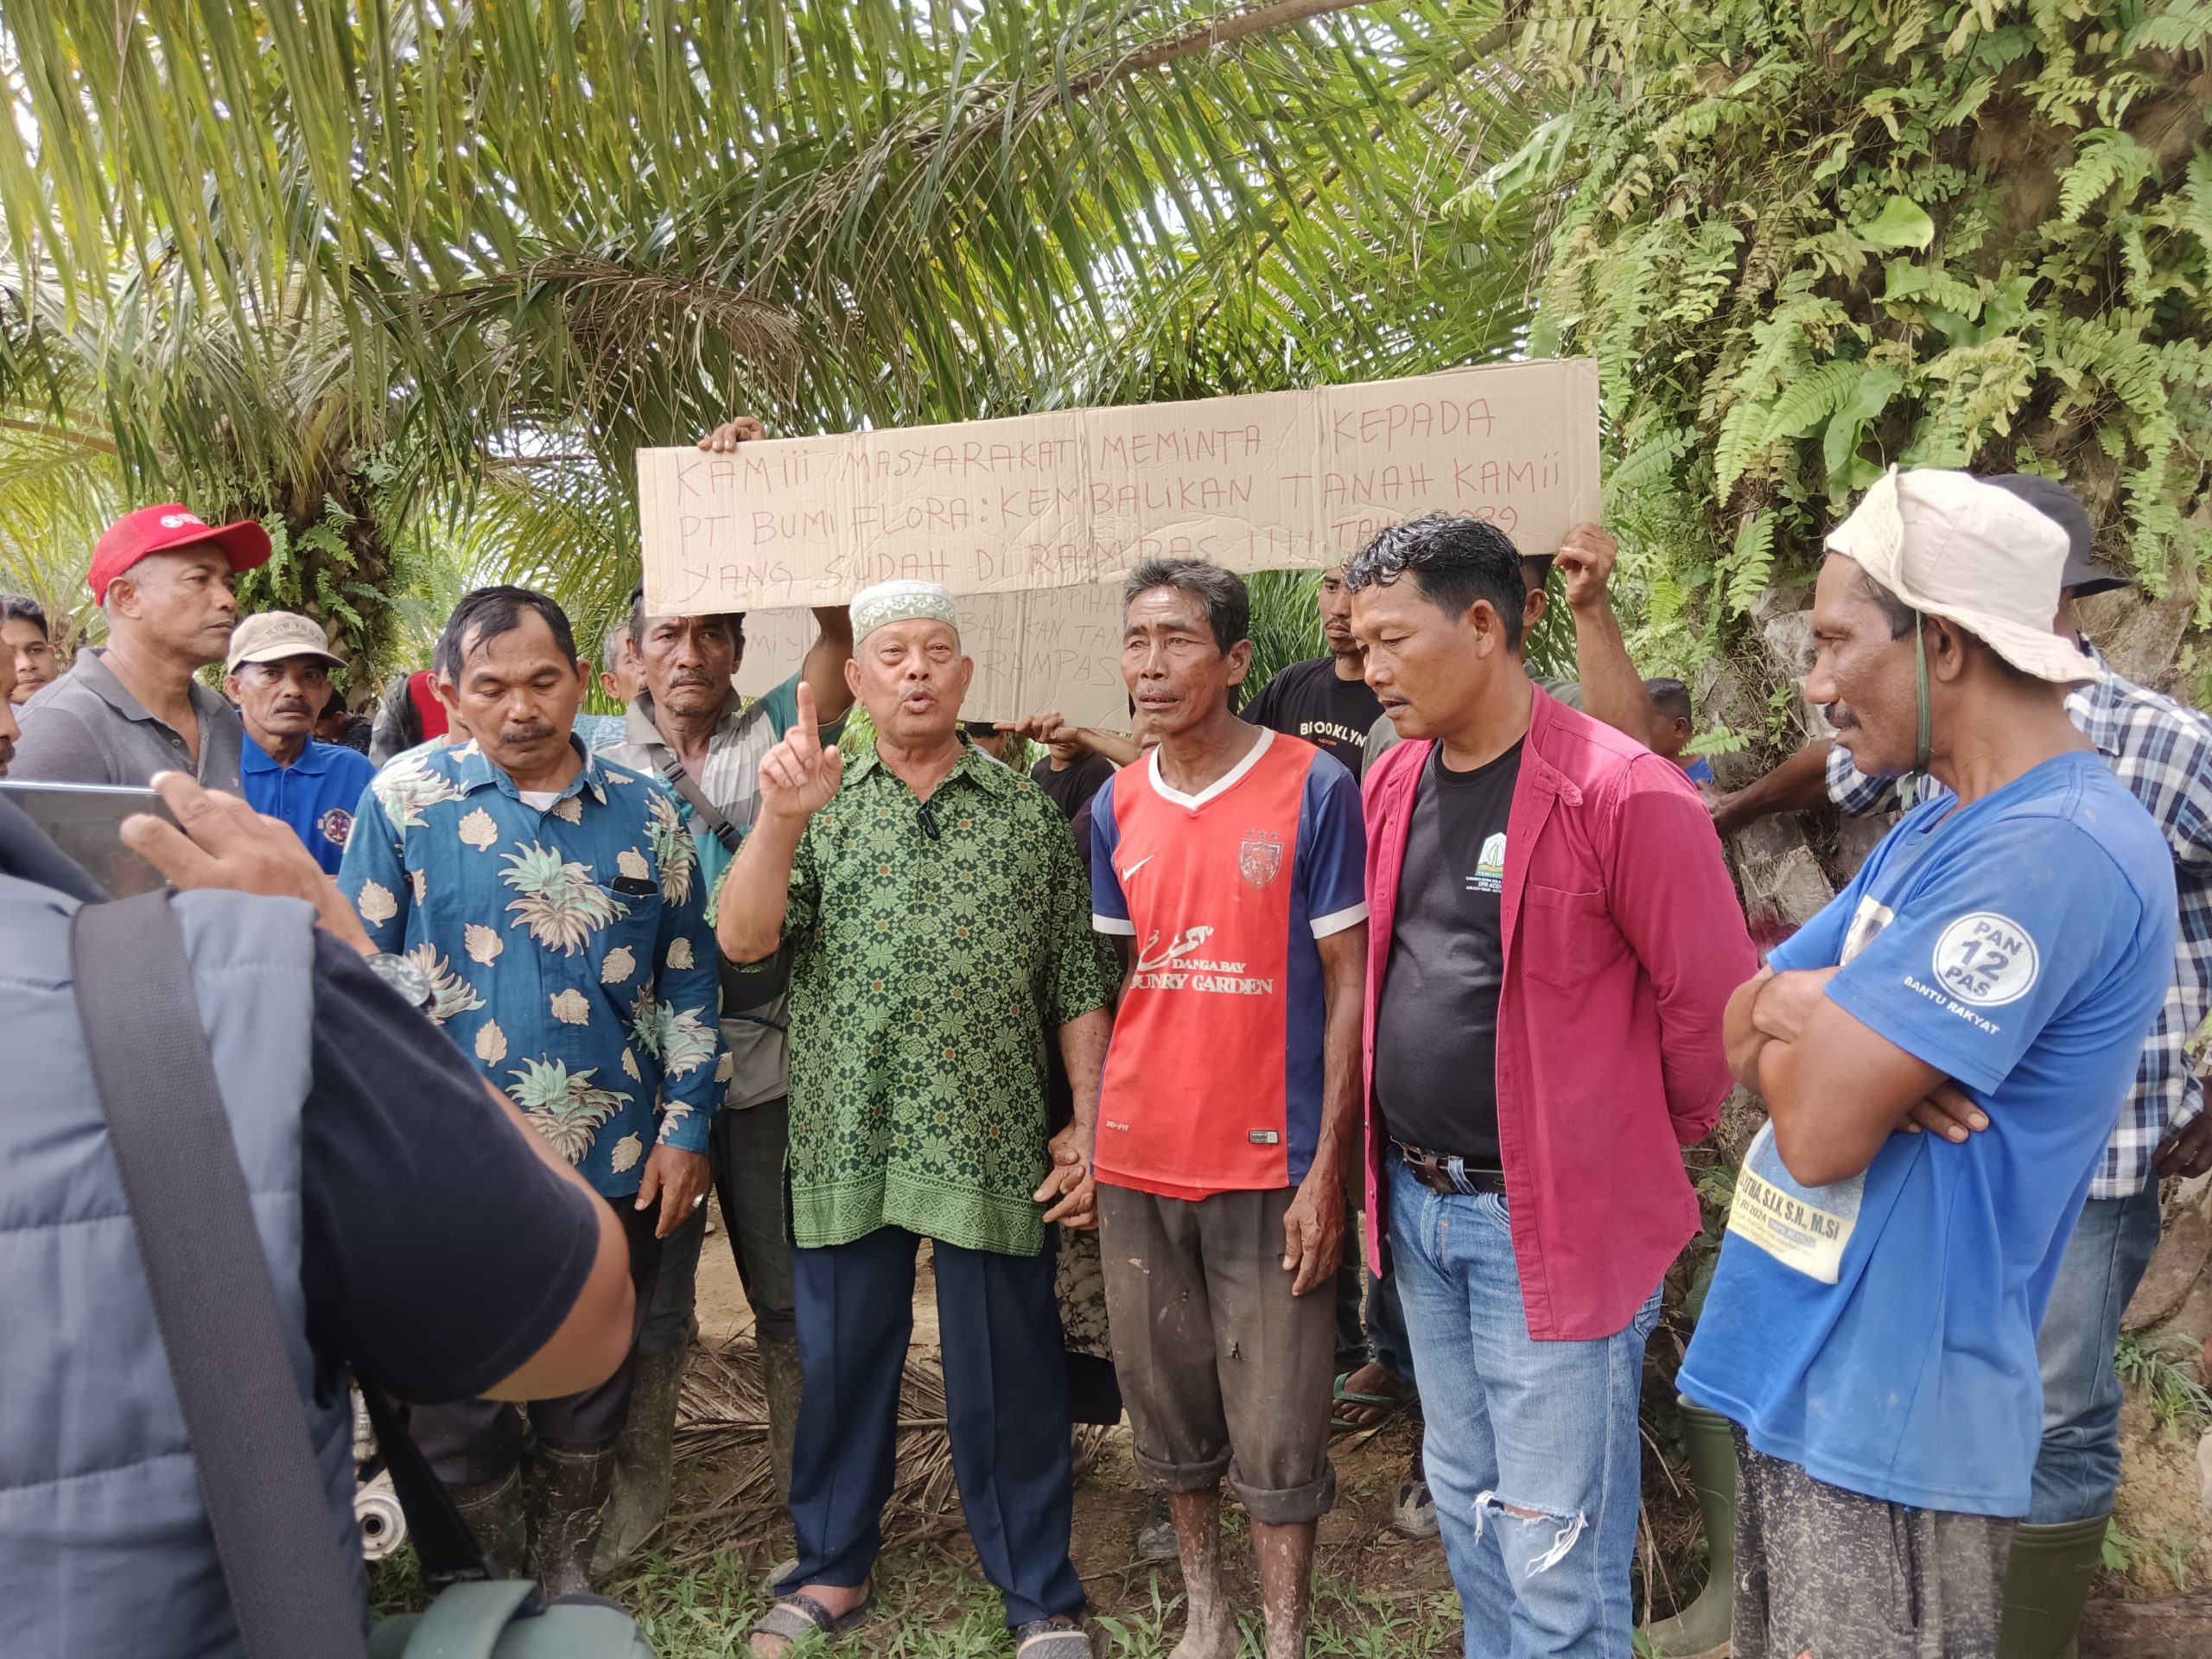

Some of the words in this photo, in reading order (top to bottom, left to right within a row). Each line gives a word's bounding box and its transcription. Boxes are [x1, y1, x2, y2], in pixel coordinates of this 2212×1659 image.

[841, 439, 1075, 483] MASYARAKAT
[1332, 398, 1496, 454] KEPADA
[679, 516, 731, 556] PT
[1281, 464, 1434, 510] TANAH
[678, 561, 793, 603] YANG
[816, 549, 950, 591] SUDAH
[1029, 535, 1218, 576] RAMPAS
[980, 650, 1118, 686] RAMPAS
[1973, 920, 2023, 956] PAN
[1172, 958, 1218, 972] DANGA
[1218, 961, 1247, 974] BAY
[1961, 939, 2010, 982] 12
[1191, 975, 1274, 995] GARDEN
[1944, 964, 1992, 997] PAS
[1904, 976, 1948, 1006] BANTU
[1946, 1001, 2001, 1035] RAKYAT
[1749, 1205, 1767, 1224] 2024
[1810, 1211, 1840, 1242] M.Si
